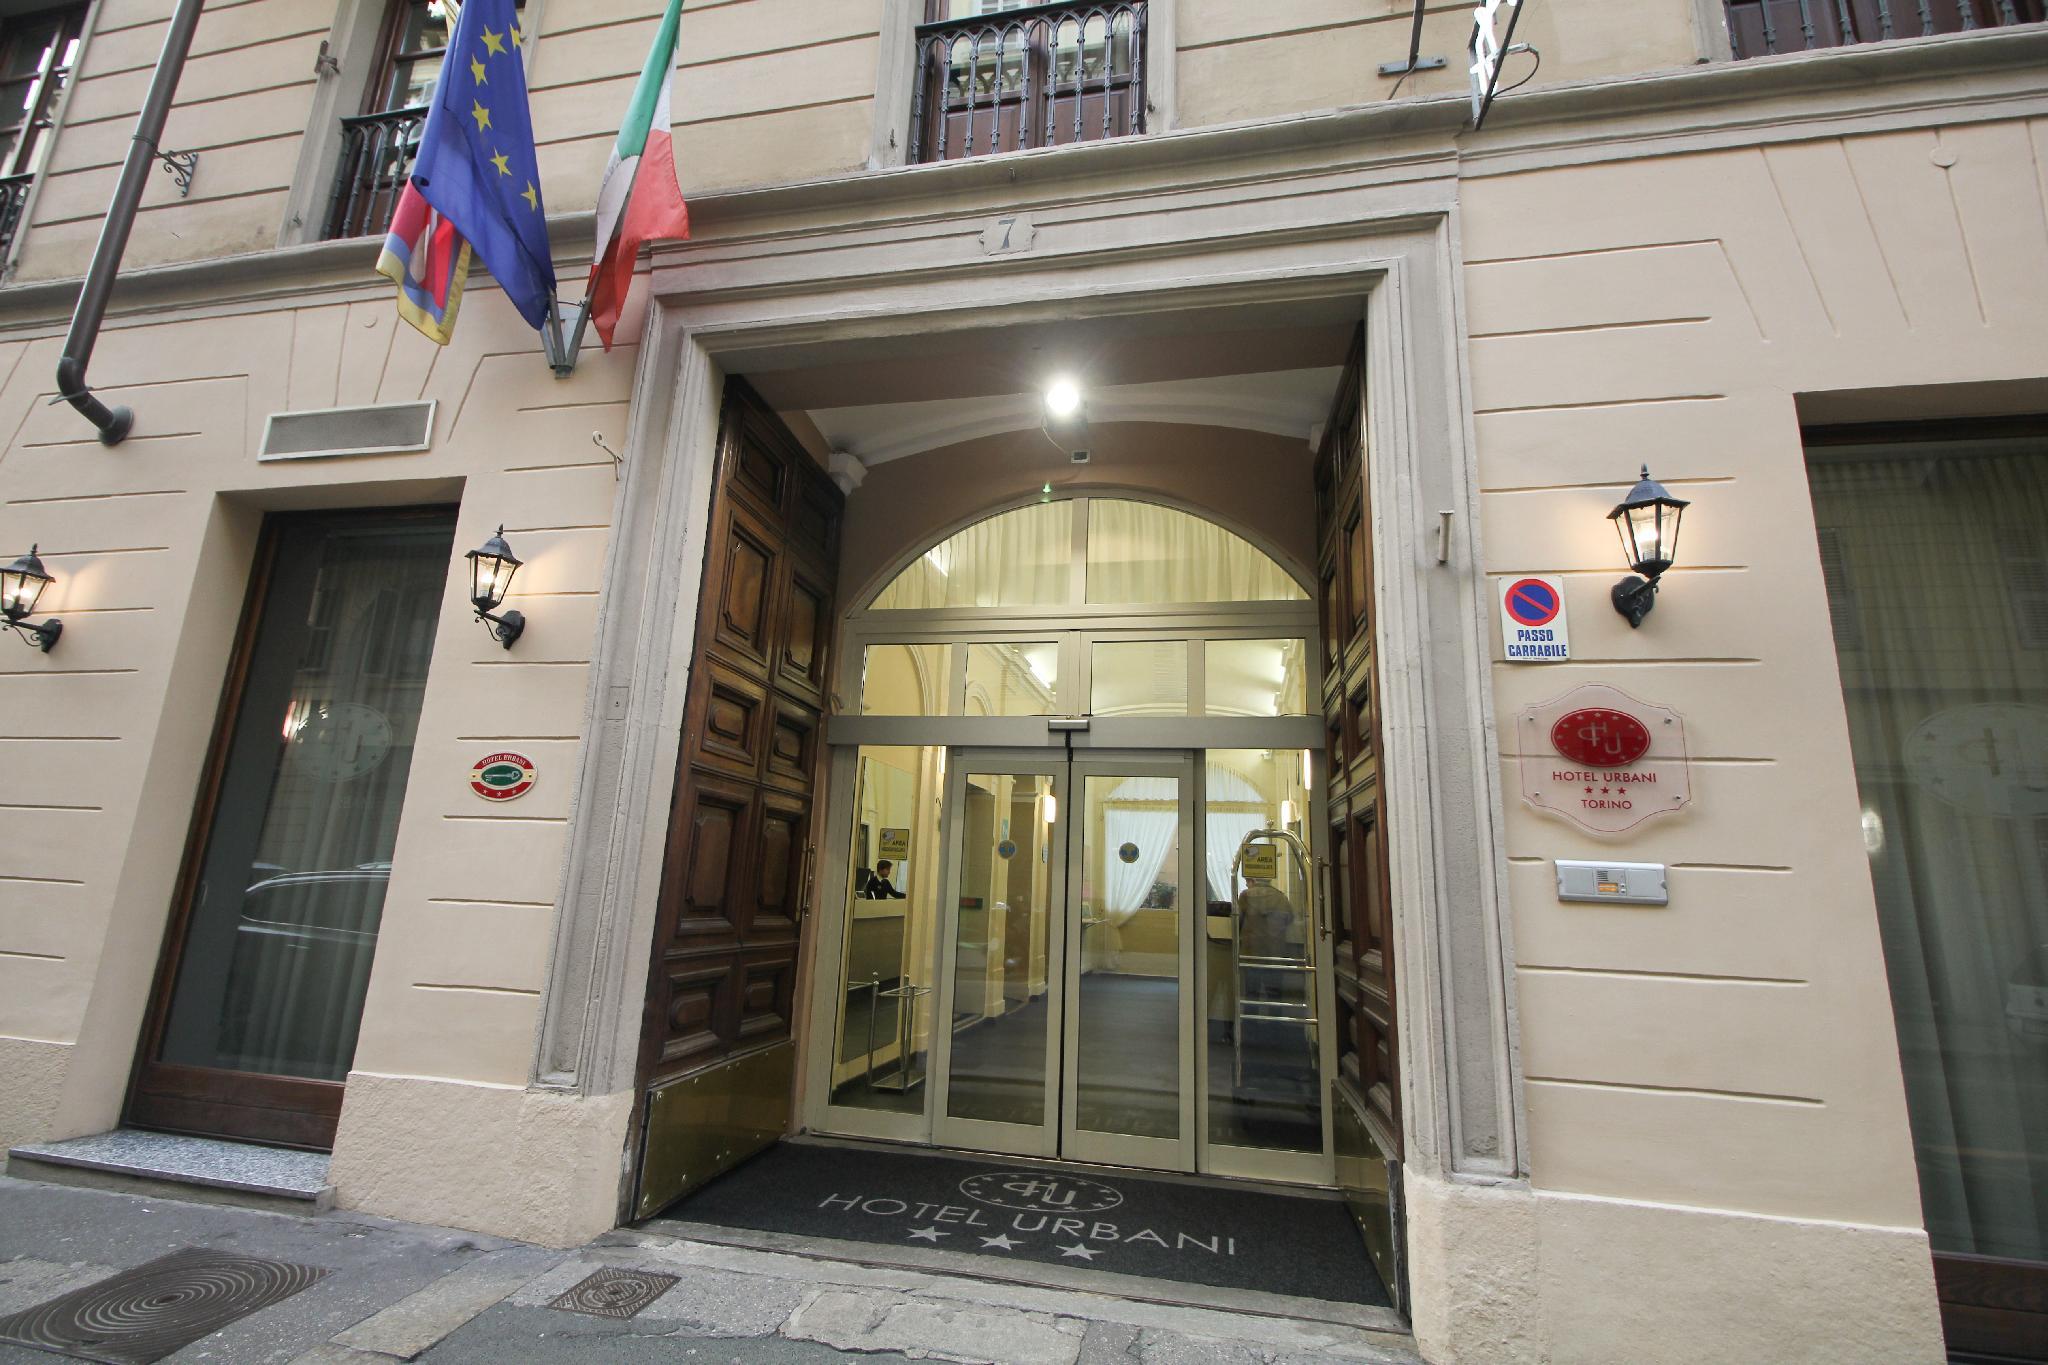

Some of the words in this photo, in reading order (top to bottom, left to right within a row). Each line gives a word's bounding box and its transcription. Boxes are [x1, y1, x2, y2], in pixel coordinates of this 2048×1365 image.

[998, 218, 1017, 249] 7
[1517, 629, 1554, 642] PASSO
[1508, 644, 1567, 657] CARRABILE
[482, 755, 503, 766] HOTEL
[1552, 771, 1599, 782] HOTEL
[1603, 772, 1657, 783] URBANI
[1581, 799, 1633, 810] TORINO
[818, 1193, 988, 1226] HOTEL
[1012, 1213, 1236, 1256] URBANI
